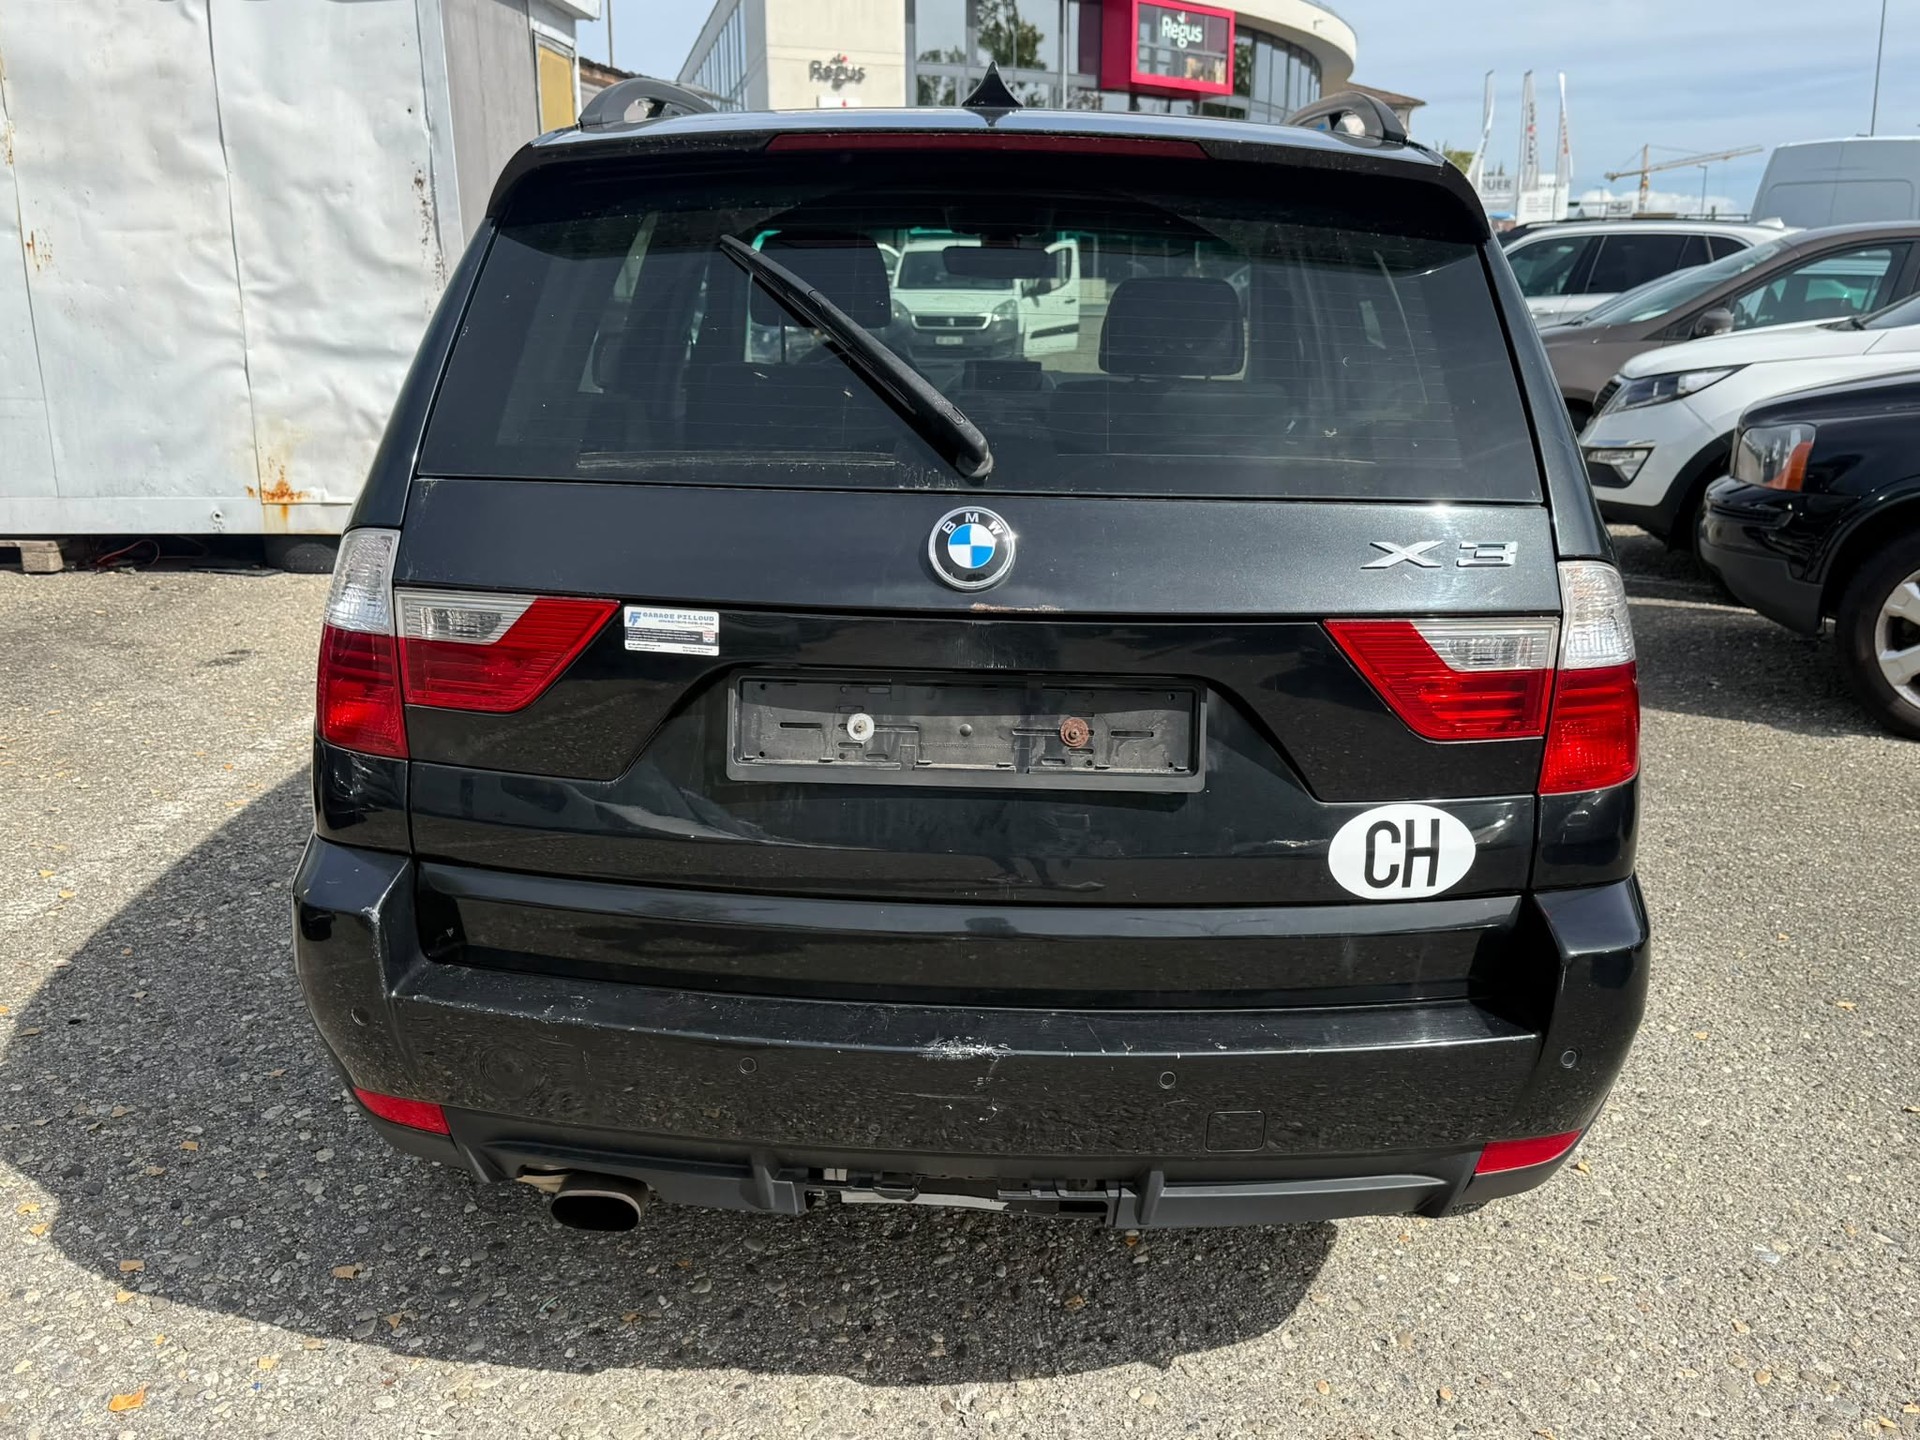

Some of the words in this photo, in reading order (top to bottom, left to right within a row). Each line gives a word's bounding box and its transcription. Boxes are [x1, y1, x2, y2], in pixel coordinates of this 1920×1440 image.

[1162, 15, 1203, 48] Regus
[809, 60, 866, 91] Regus
[942, 512, 1004, 536] BMW
[1360, 540, 1519, 570] X3
[642, 611, 675, 620] GARAGE
[1364, 818, 1440, 889] CH
